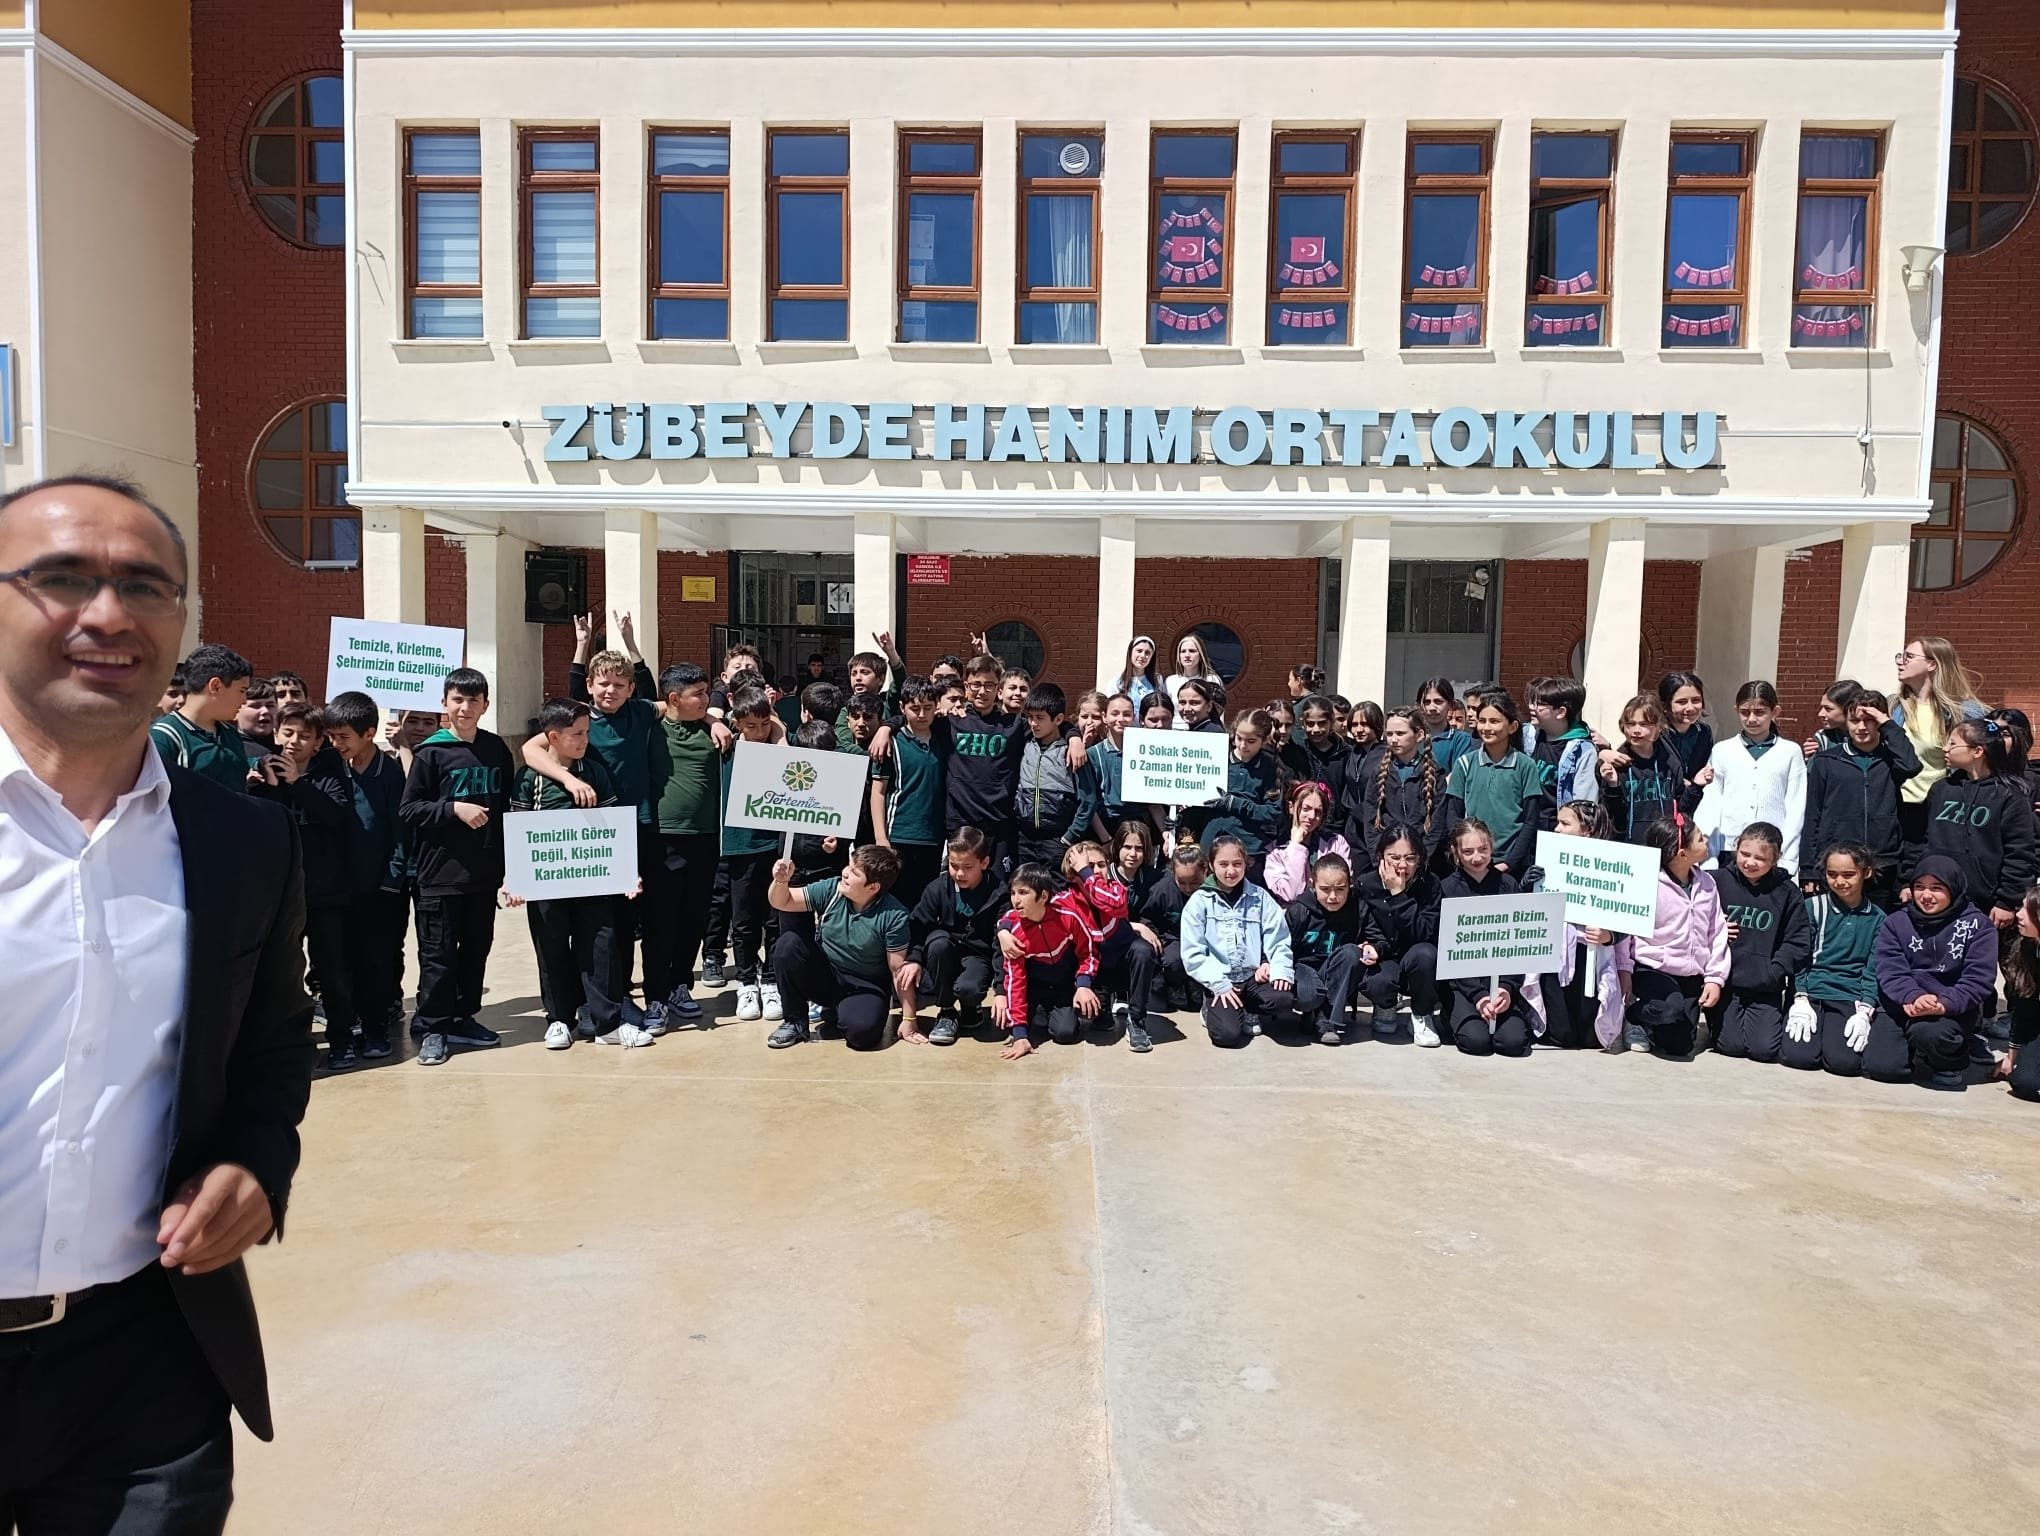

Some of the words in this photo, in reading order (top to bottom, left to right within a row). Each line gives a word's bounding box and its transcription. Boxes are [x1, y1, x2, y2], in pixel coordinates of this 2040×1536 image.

[541, 401, 913, 461] ZÜBEYDE
[933, 403, 1192, 464] HANIM
[1210, 406, 1717, 470] ORTAOKULU
[348, 637, 393, 655] Temizle,
[396, 641, 445, 659] Kirletme,
[336, 654, 395, 672] Şehrimizin
[365, 675, 424, 693] Söndürme!
[956, 732, 1007, 758] ZHO
[1139, 744, 1146, 755] O
[1148, 744, 1179, 757] Sokak
[1181, 746, 1213, 760] Senin,
[1130, 759, 1137, 770] O
[1139, 759, 1173, 773] Zaman
[1175, 762, 1192, 774] Her
[1195, 763, 1221, 775] Yerin
[1144, 776, 1172, 788] Temiz
[1175, 778, 1206, 790] Olsun!
[764, 790, 821, 809] Tertemiz
[744, 794, 842, 826] KARAMAN
[526, 828, 578, 844] Temizlik
[581, 827, 617, 840] Görev
[531, 847, 567, 863] Değil,
[571, 846, 613, 861] Kişinin
[535, 864, 610, 882] Karakteridir.
[1559, 851, 1570, 865] El
[1573, 854, 1590, 868] Ele
[1594, 857, 1634, 877] Verdik,
[1590, 894, 1650, 917] Yapıyoruz!
[1457, 913, 1509, 926] Karaman
[1512, 909, 1548, 923] Bizim,
[1727, 904, 1774, 931] ZHO
[1455, 928, 1510, 945] Şehrimizi
[1514, 926, 1548, 940] Temiz
[1447, 947, 1488, 961] Tutmak
[1491, 943, 1553, 959] Hepimizin!
